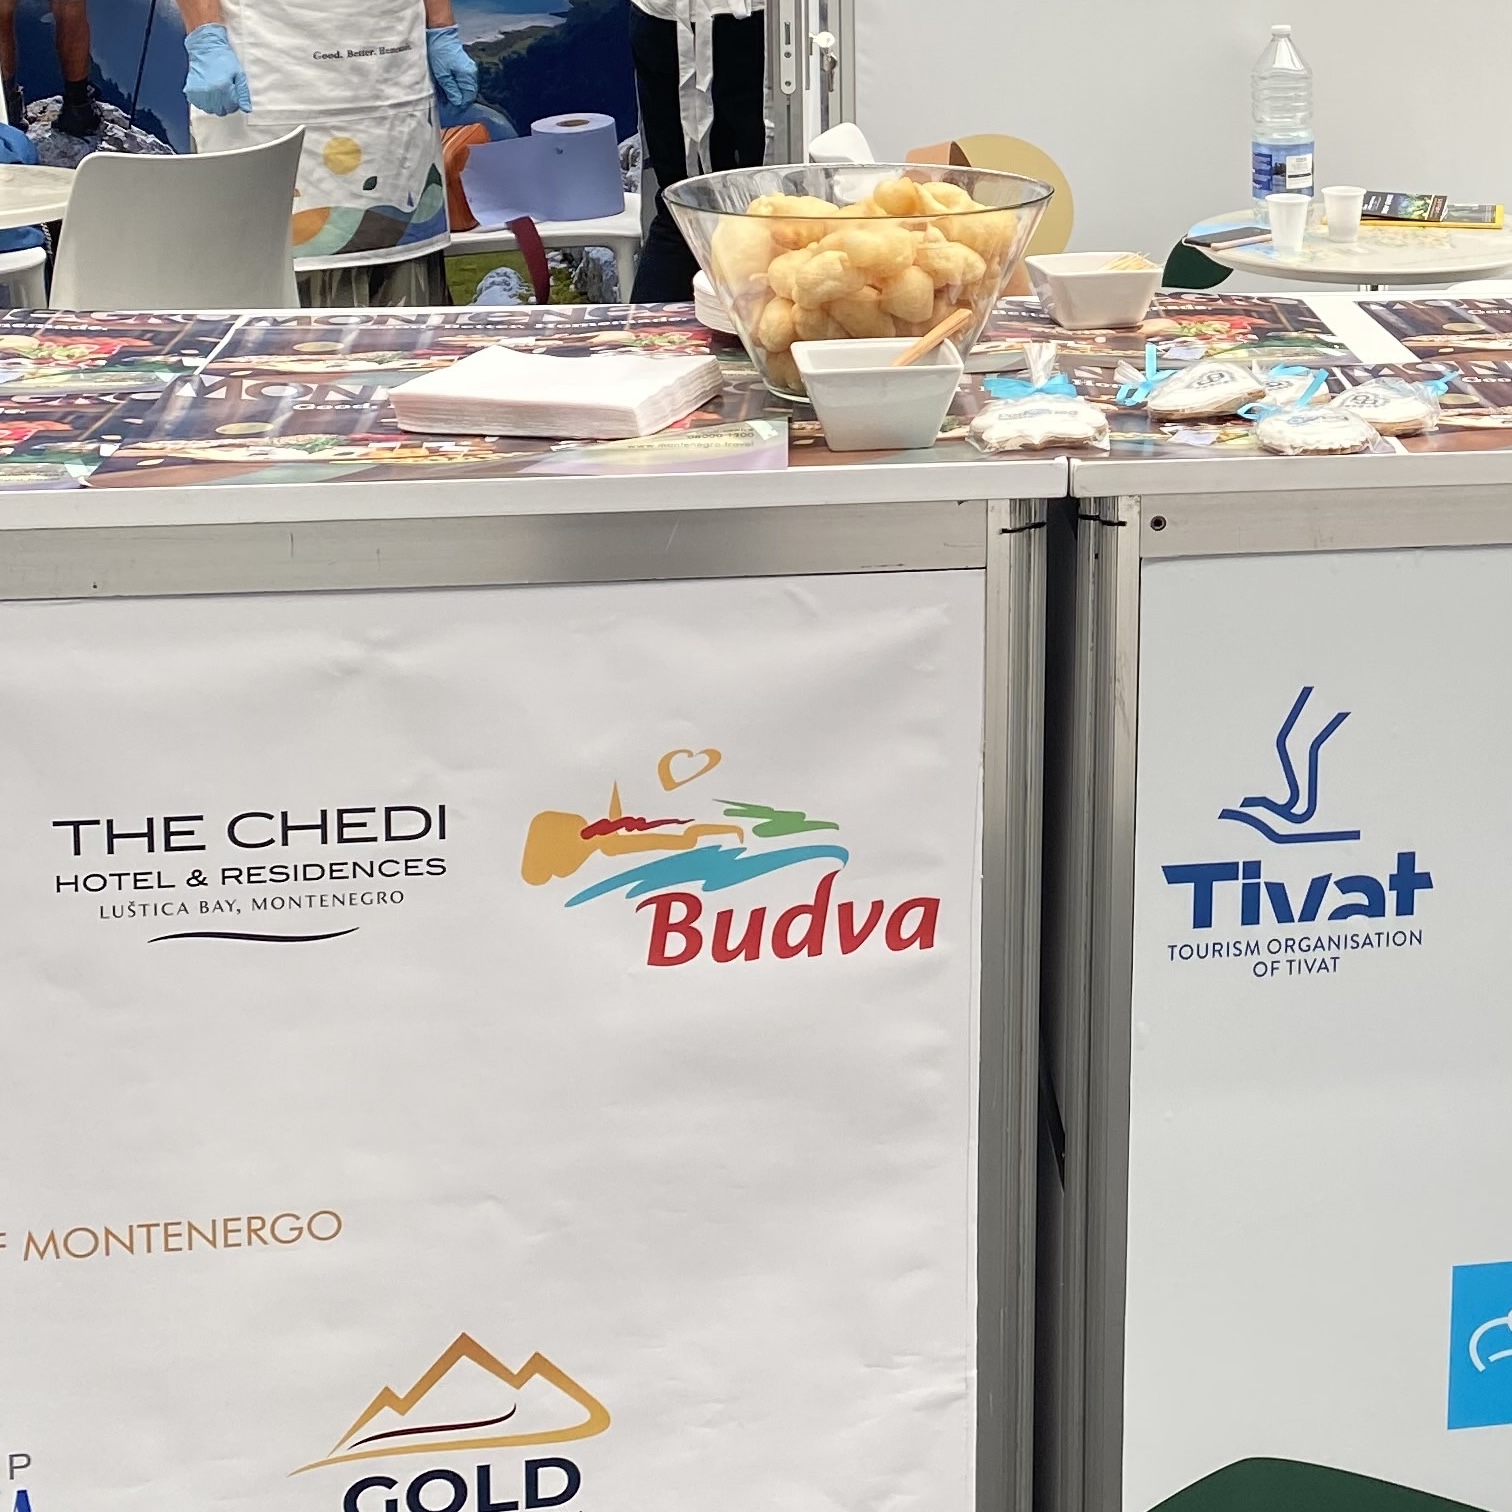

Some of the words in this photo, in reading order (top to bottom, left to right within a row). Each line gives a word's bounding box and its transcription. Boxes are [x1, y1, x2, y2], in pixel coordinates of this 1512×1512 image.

[312, 50, 344, 61] Good.
[52, 814, 207, 857] THE
[226, 804, 447, 850] CHEDI
[55, 871, 176, 894] HOTEL
[185, 869, 208, 888] &
[220, 858, 448, 886] RESIDENCES
[1161, 850, 1434, 930] Tivat
[100, 900, 190, 920] LUŠTICA
[199, 898, 242, 916] BAY,
[251, 890, 405, 912] MONTENEGRO
[635, 869, 941, 968] Budva
[1168, 940, 1261, 961] TOURISM
[1266, 928, 1423, 956] ORGANISATION
[1253, 960, 1280, 978] OF
[1286, 956, 1341, 976] TIVAT
[23, 1209, 343, 1262] MONTENERGO
[343, 1456, 582, 1512] GOLD
